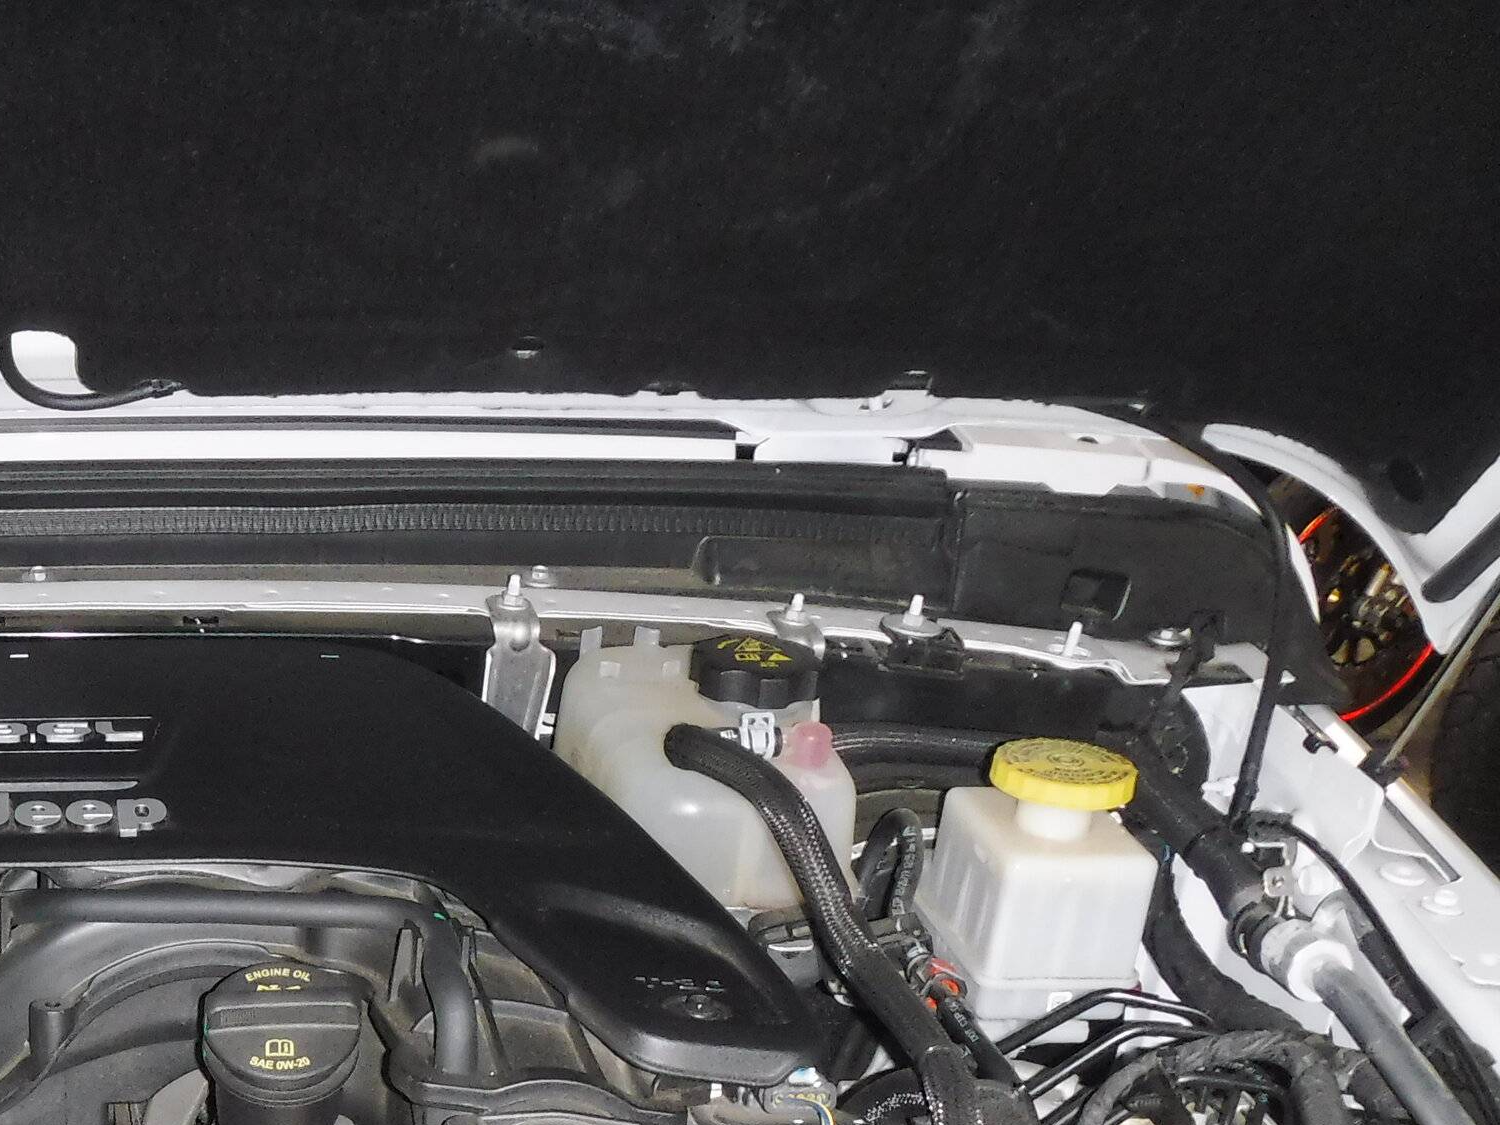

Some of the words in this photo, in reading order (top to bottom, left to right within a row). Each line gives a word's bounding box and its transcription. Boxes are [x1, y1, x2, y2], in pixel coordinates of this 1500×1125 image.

[245, 967, 290, 982] ENGINE
[293, 969, 311, 982] OIL
[250, 1056, 274, 1070] SAE
[276, 1056, 311, 1070] 0W-20
